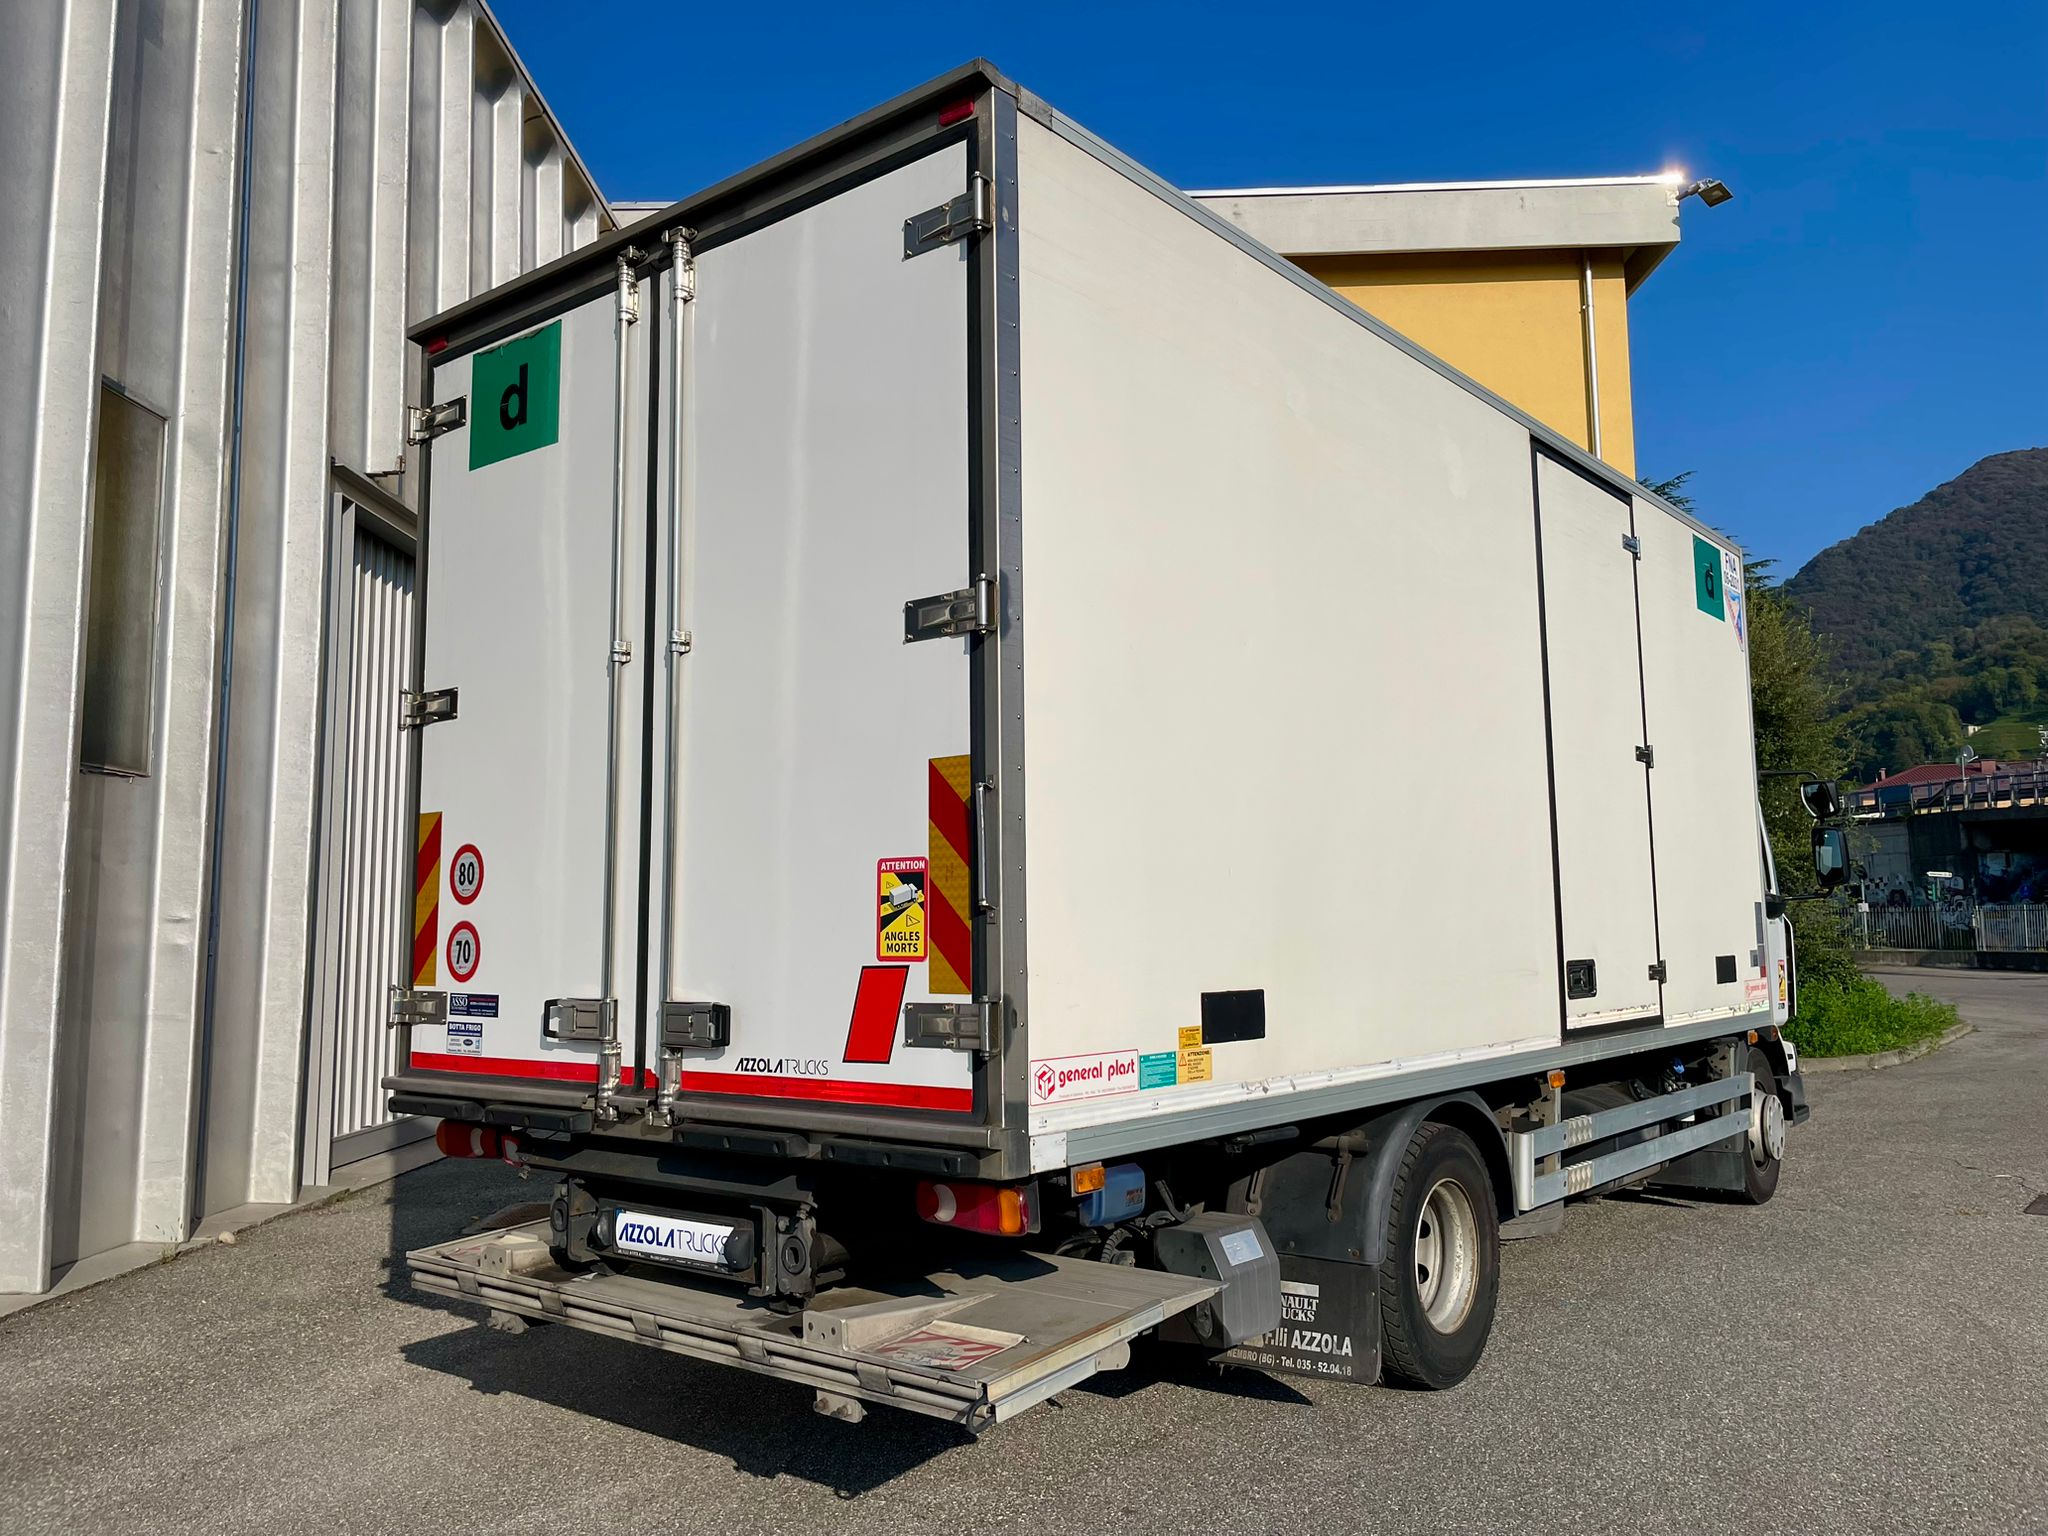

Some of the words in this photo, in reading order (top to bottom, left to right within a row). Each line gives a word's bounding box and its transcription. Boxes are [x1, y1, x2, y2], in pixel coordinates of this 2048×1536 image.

[500, 362, 529, 431] d
[1705, 561, 1715, 600] d
[458, 861, 475, 886] 80
[881, 861, 925, 871] ATTENTION
[884, 931, 920, 942] ANGLES
[455, 939, 471, 965] 70
[886, 943, 919, 953] MORTS
[452, 997, 468, 1007] ASSO
[465, 1024, 482, 1032] FRIGO
[1058, 1060, 1103, 1088] general
[1107, 1058, 1136, 1082] plast
[1280, 1294, 1319, 1311] NAULT
[1282, 1307, 1315, 1323] UCKS
[1290, 1329, 1353, 1357] AZZOLA
[1258, 1352, 1275, 1366] (BG)
[1281, 1356, 1295, 1368] Tel.
[1296, 1358, 1312, 1371] 035
[1317, 1361, 1352, 1377] 52.04.18
